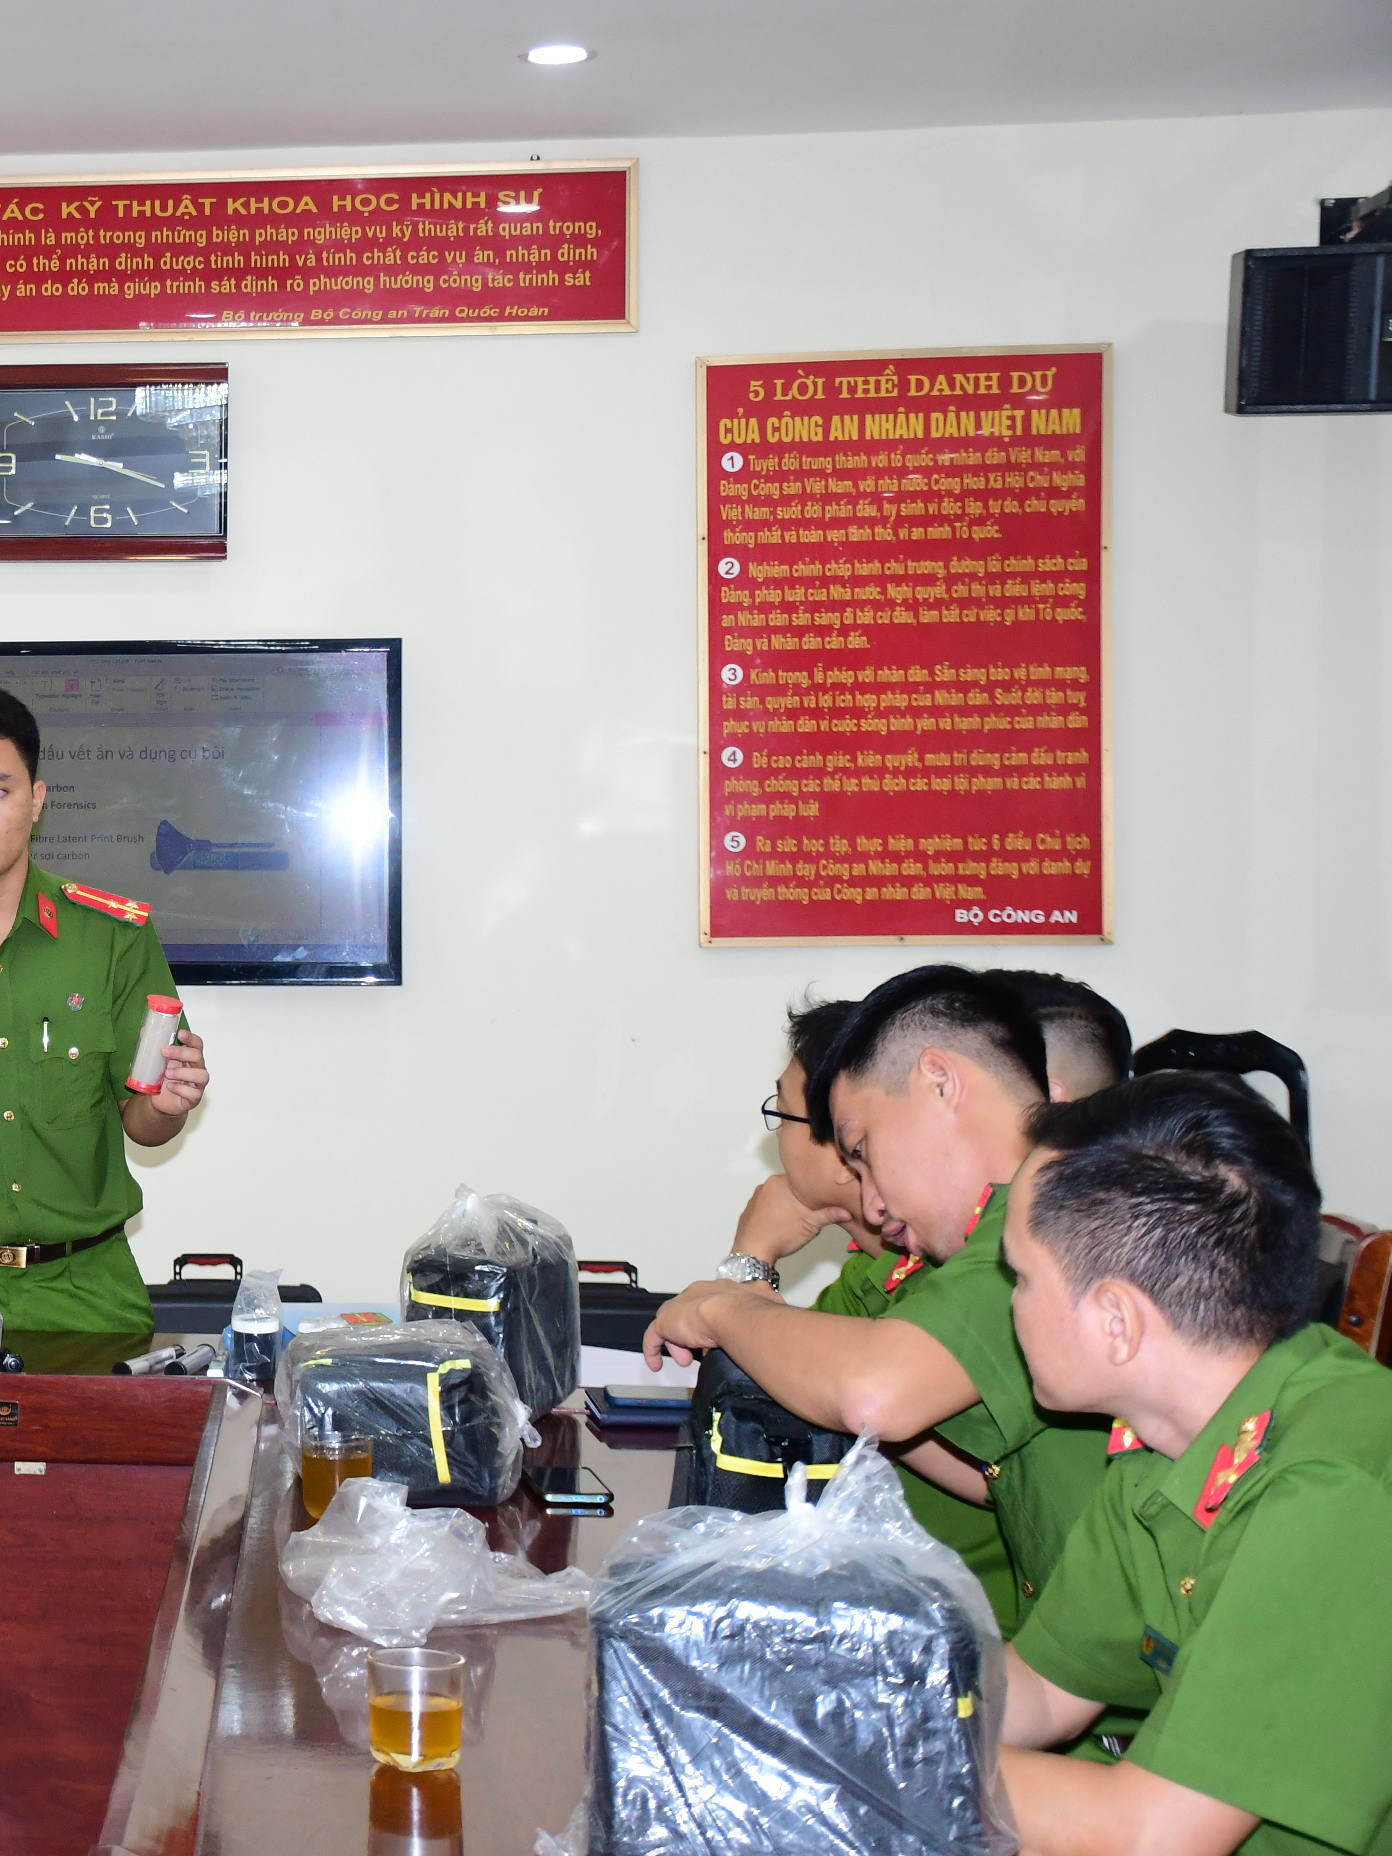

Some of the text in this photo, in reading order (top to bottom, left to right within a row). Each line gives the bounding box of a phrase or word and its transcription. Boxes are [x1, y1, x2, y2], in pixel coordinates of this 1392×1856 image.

[61, 196, 102, 218] KỸ
[111, 194, 216, 220] THUẬT
[227, 195, 317, 215] KHOA
[333, 193, 399, 216] HỌC
[411, 186, 488, 212] HÌNH
[41, 228, 55, 244] là
[61, 227, 93, 248] một
[99, 228, 144, 248] trong
[152, 226, 206, 247] những
[212, 225, 248, 246] biện
[256, 224, 298, 245] pháp
[304, 222, 361, 244] nghiệp
[365, 225, 385, 242] vụ
[392, 217, 412, 241] kỹ
[415, 217, 464, 241] thuật
[470, 216, 493, 235] rất
[499, 222, 542, 239] quan
[549, 218, 601, 239] trọng,
[749, 380, 764, 401] 5
[773, 369, 825, 400] LỜI
[907, 372, 1000, 395] DANH
[1010, 367, 1056, 396] DỰ
[89, 397, 117, 420] 12
[719, 403, 1080, 444] CỦA CÔNG AN NHÂN DÂN VIỆT NAM
[188, 450, 211, 473] 3
[90, 505, 112, 528] 6
[68, 744, 92, 761] vết
[118, 747, 134, 760] và
[139, 747, 176, 763] dụng
[180, 749, 197, 764] cụ
[46, 784, 75, 793] arbon
[50, 801, 97, 810] Forensics
[58, 834, 87, 844] Latent
[91, 834, 114, 843] Print
[117, 834, 144, 843] Brush
[57, 851, 90, 860] carbon
[955, 906, 1077, 925] BỘ CÔNG AN
